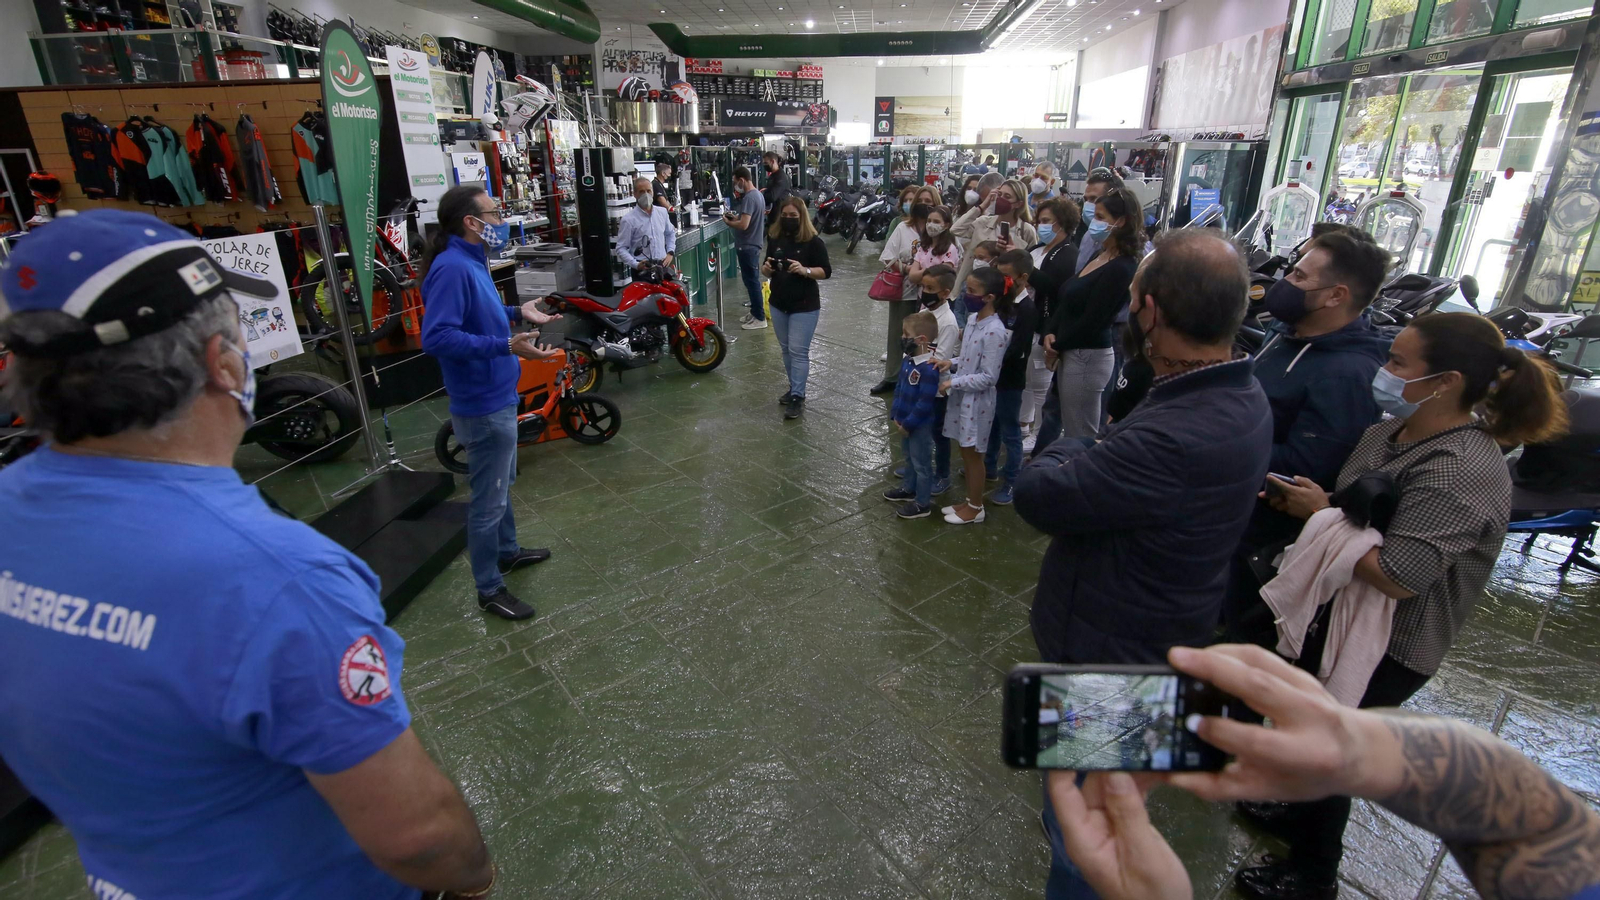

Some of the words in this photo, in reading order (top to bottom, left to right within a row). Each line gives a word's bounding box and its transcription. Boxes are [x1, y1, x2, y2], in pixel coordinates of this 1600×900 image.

[1428, 53, 1446, 62] SALIDA
[1354, 65, 1369, 73] SALIDA
[394, 73, 400, 81] el
[400, 73, 429, 86] Motorista
[332, 102, 339, 117] el
[340, 102, 378, 119] Motorista
[256, 244, 271, 259] DE
[232, 256, 269, 275] JEREZ
